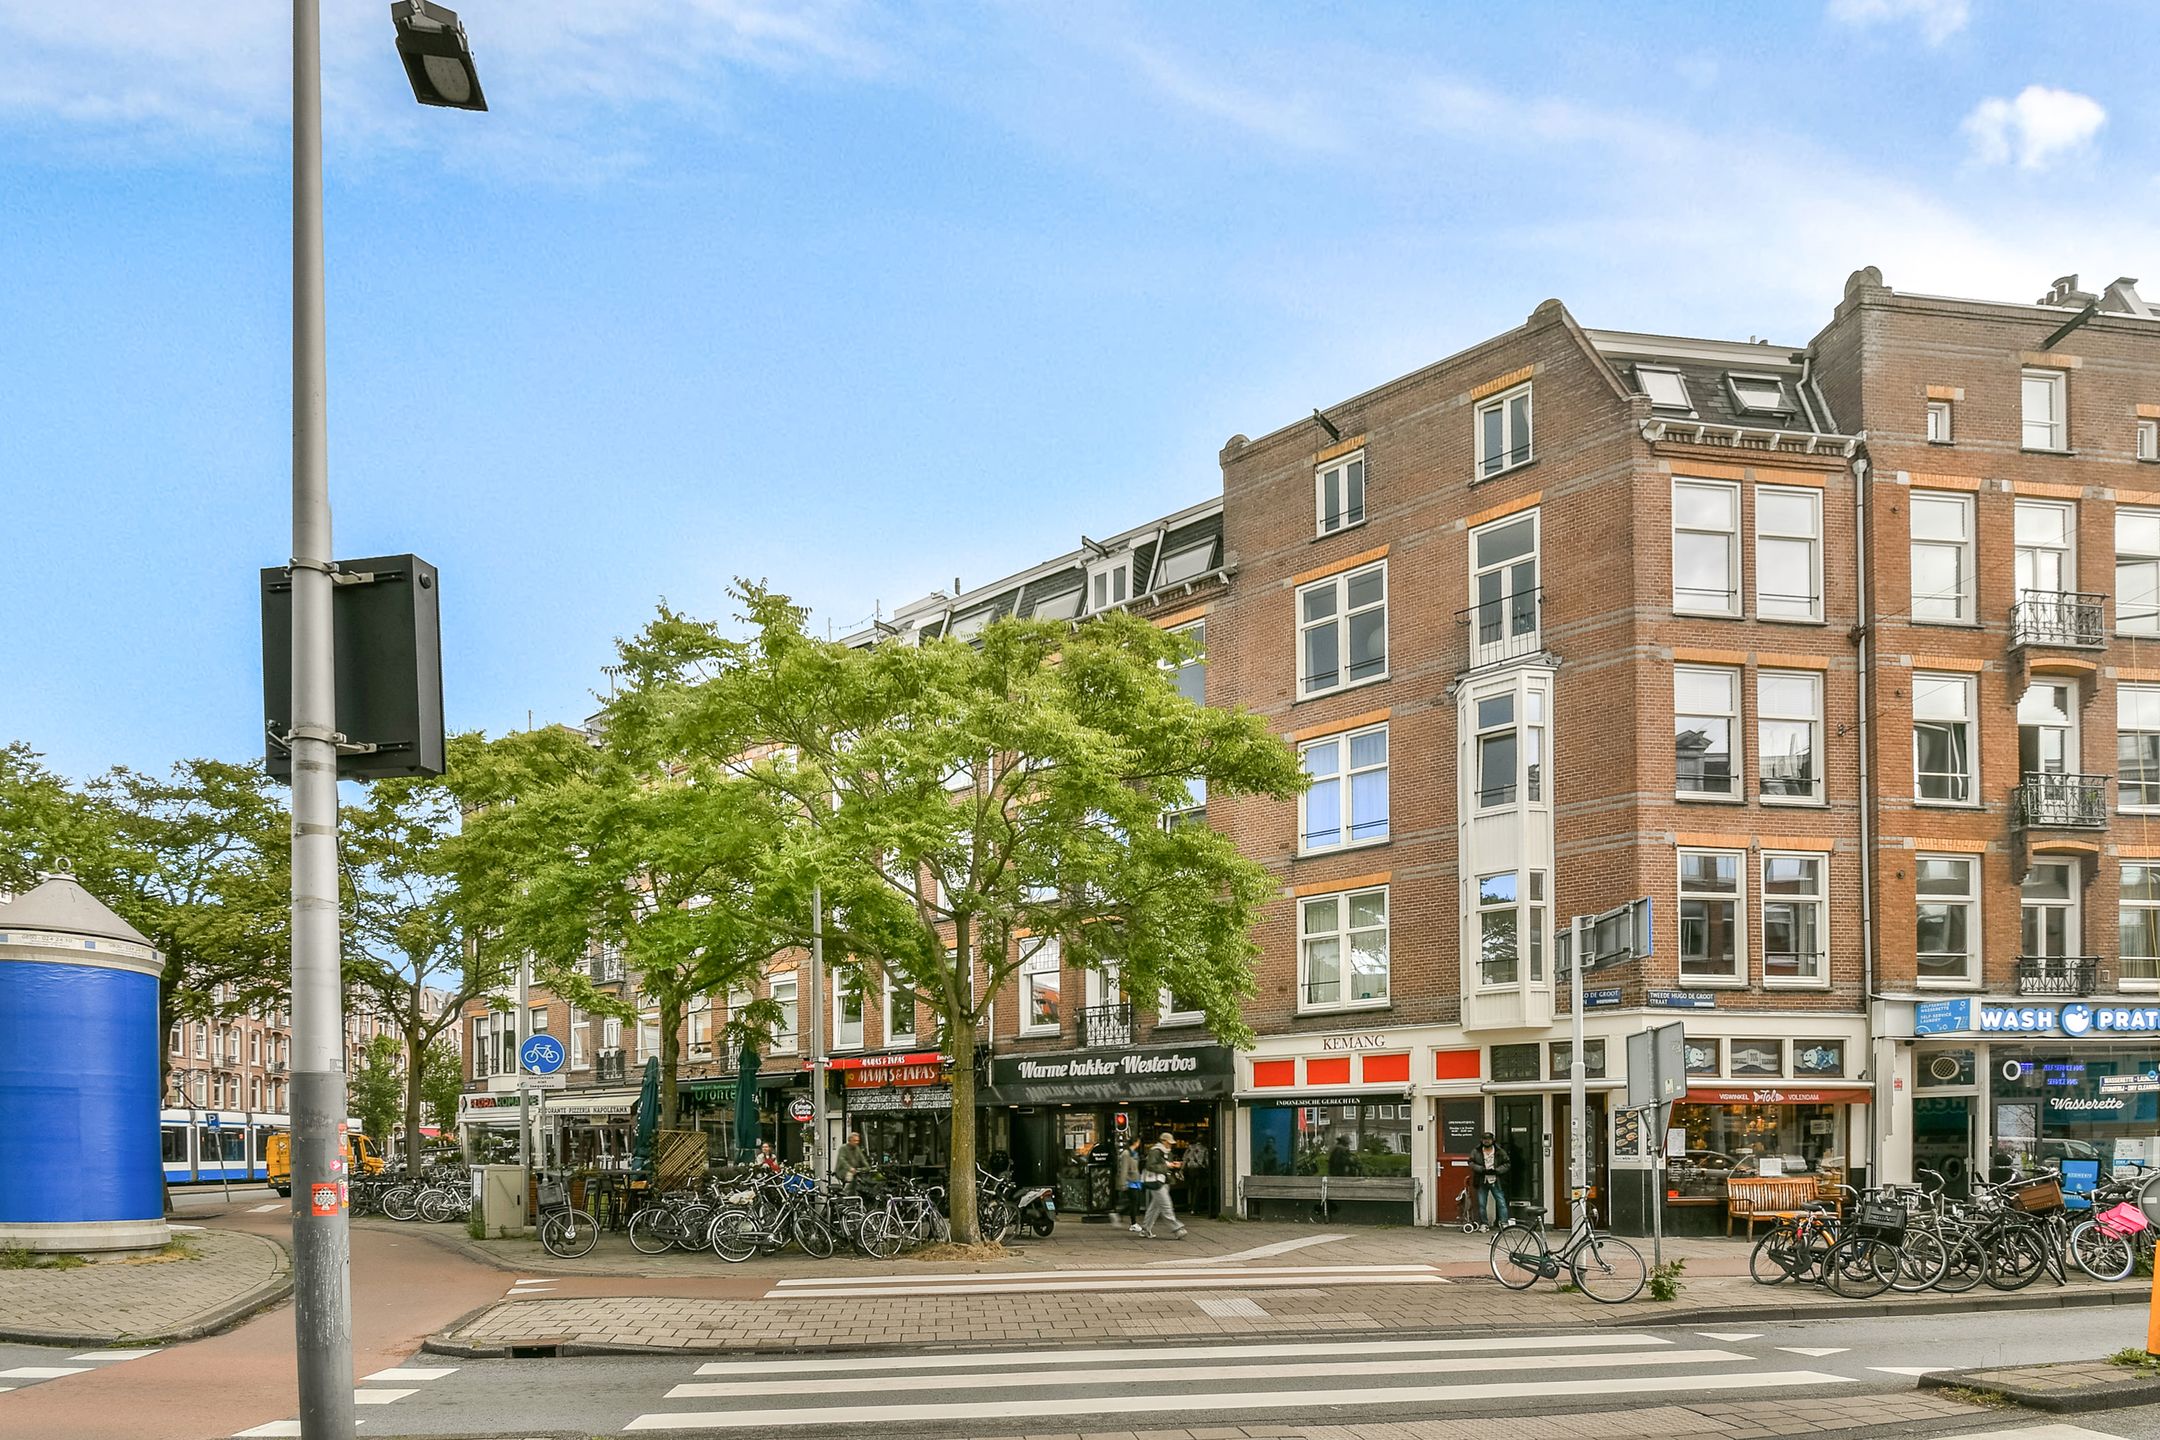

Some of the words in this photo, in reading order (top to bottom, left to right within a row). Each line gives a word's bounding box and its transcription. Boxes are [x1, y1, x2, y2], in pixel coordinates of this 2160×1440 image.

[1599, 990, 1619, 998] GROOT
[1981, 1010, 2052, 1029] WASH
[1322, 1034, 1386, 1051] KEMANG
[887, 1055, 905, 1065] TAPAS
[1017, 1061, 1069, 1079] Warme
[1069, 1058, 1120, 1077] bakker
[1120, 1054, 1197, 1075] Westerbos
[858, 1068, 895, 1083] MAMAS
[902, 1065, 935, 1081] TAPAS
[1321, 1097, 1361, 1105] GERECHTEN
[1718, 1093, 1750, 1101] VISWINKEL
[1787, 1093, 1820, 1101] VOLENDAM
[2050, 1097, 2125, 1110] Wasserette
[538, 1106, 566, 1114] RTORANTE
[593, 1105, 628, 1113] NAPOLETANA
